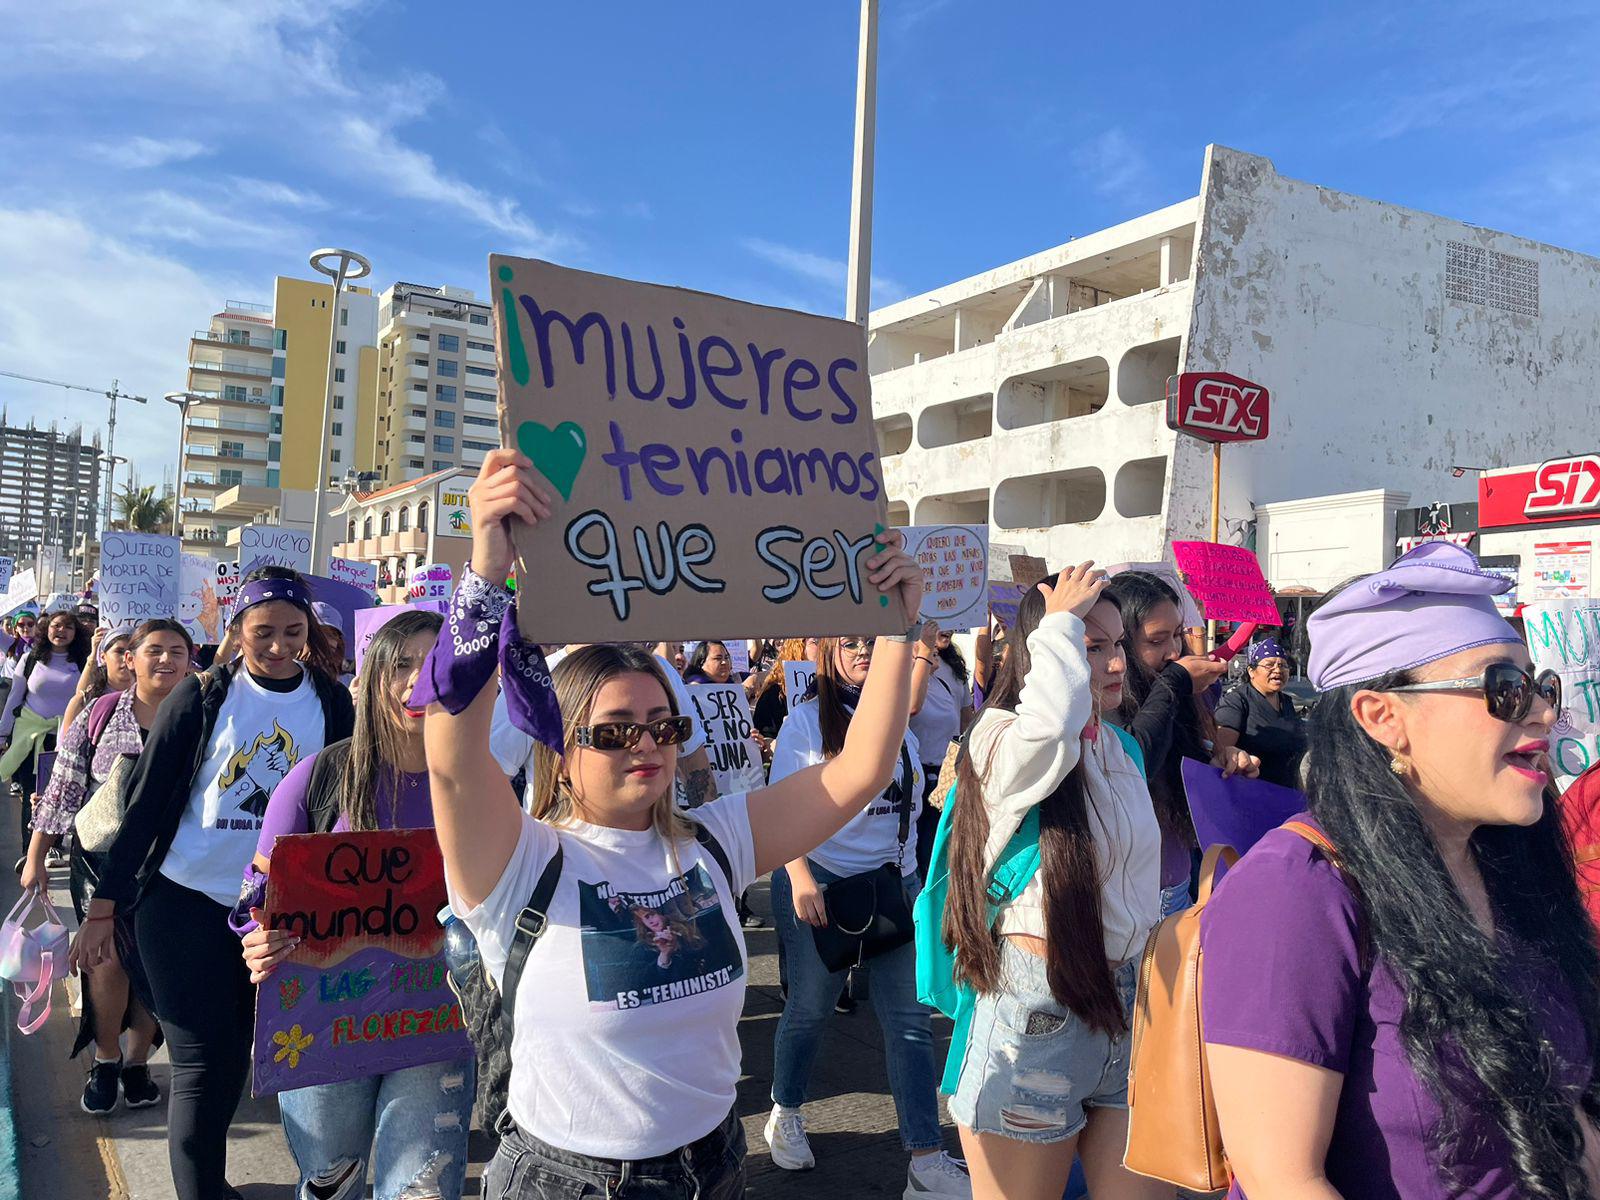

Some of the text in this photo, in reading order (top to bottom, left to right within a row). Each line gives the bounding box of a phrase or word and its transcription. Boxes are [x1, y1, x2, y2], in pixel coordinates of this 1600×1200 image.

[601, 420, 880, 502] teniamos
[103, 537, 174, 560] QUIERO
[102, 564, 174, 577] MORIR DE
[564, 509, 726, 621] que
[101, 582, 165, 597] VIEJA Y
[429, 585, 445, 596] SE
[102, 601, 120, 613] NO
[127, 600, 151, 615] POR
[707, 690, 745, 720] SER
[723, 719, 751, 741] NO
[216, 818, 229, 830] NI
[230, 818, 253, 831] UNA
[271, 888, 420, 941] mundo
[616, 964, 733, 1010] ES "FEMINISTA"
